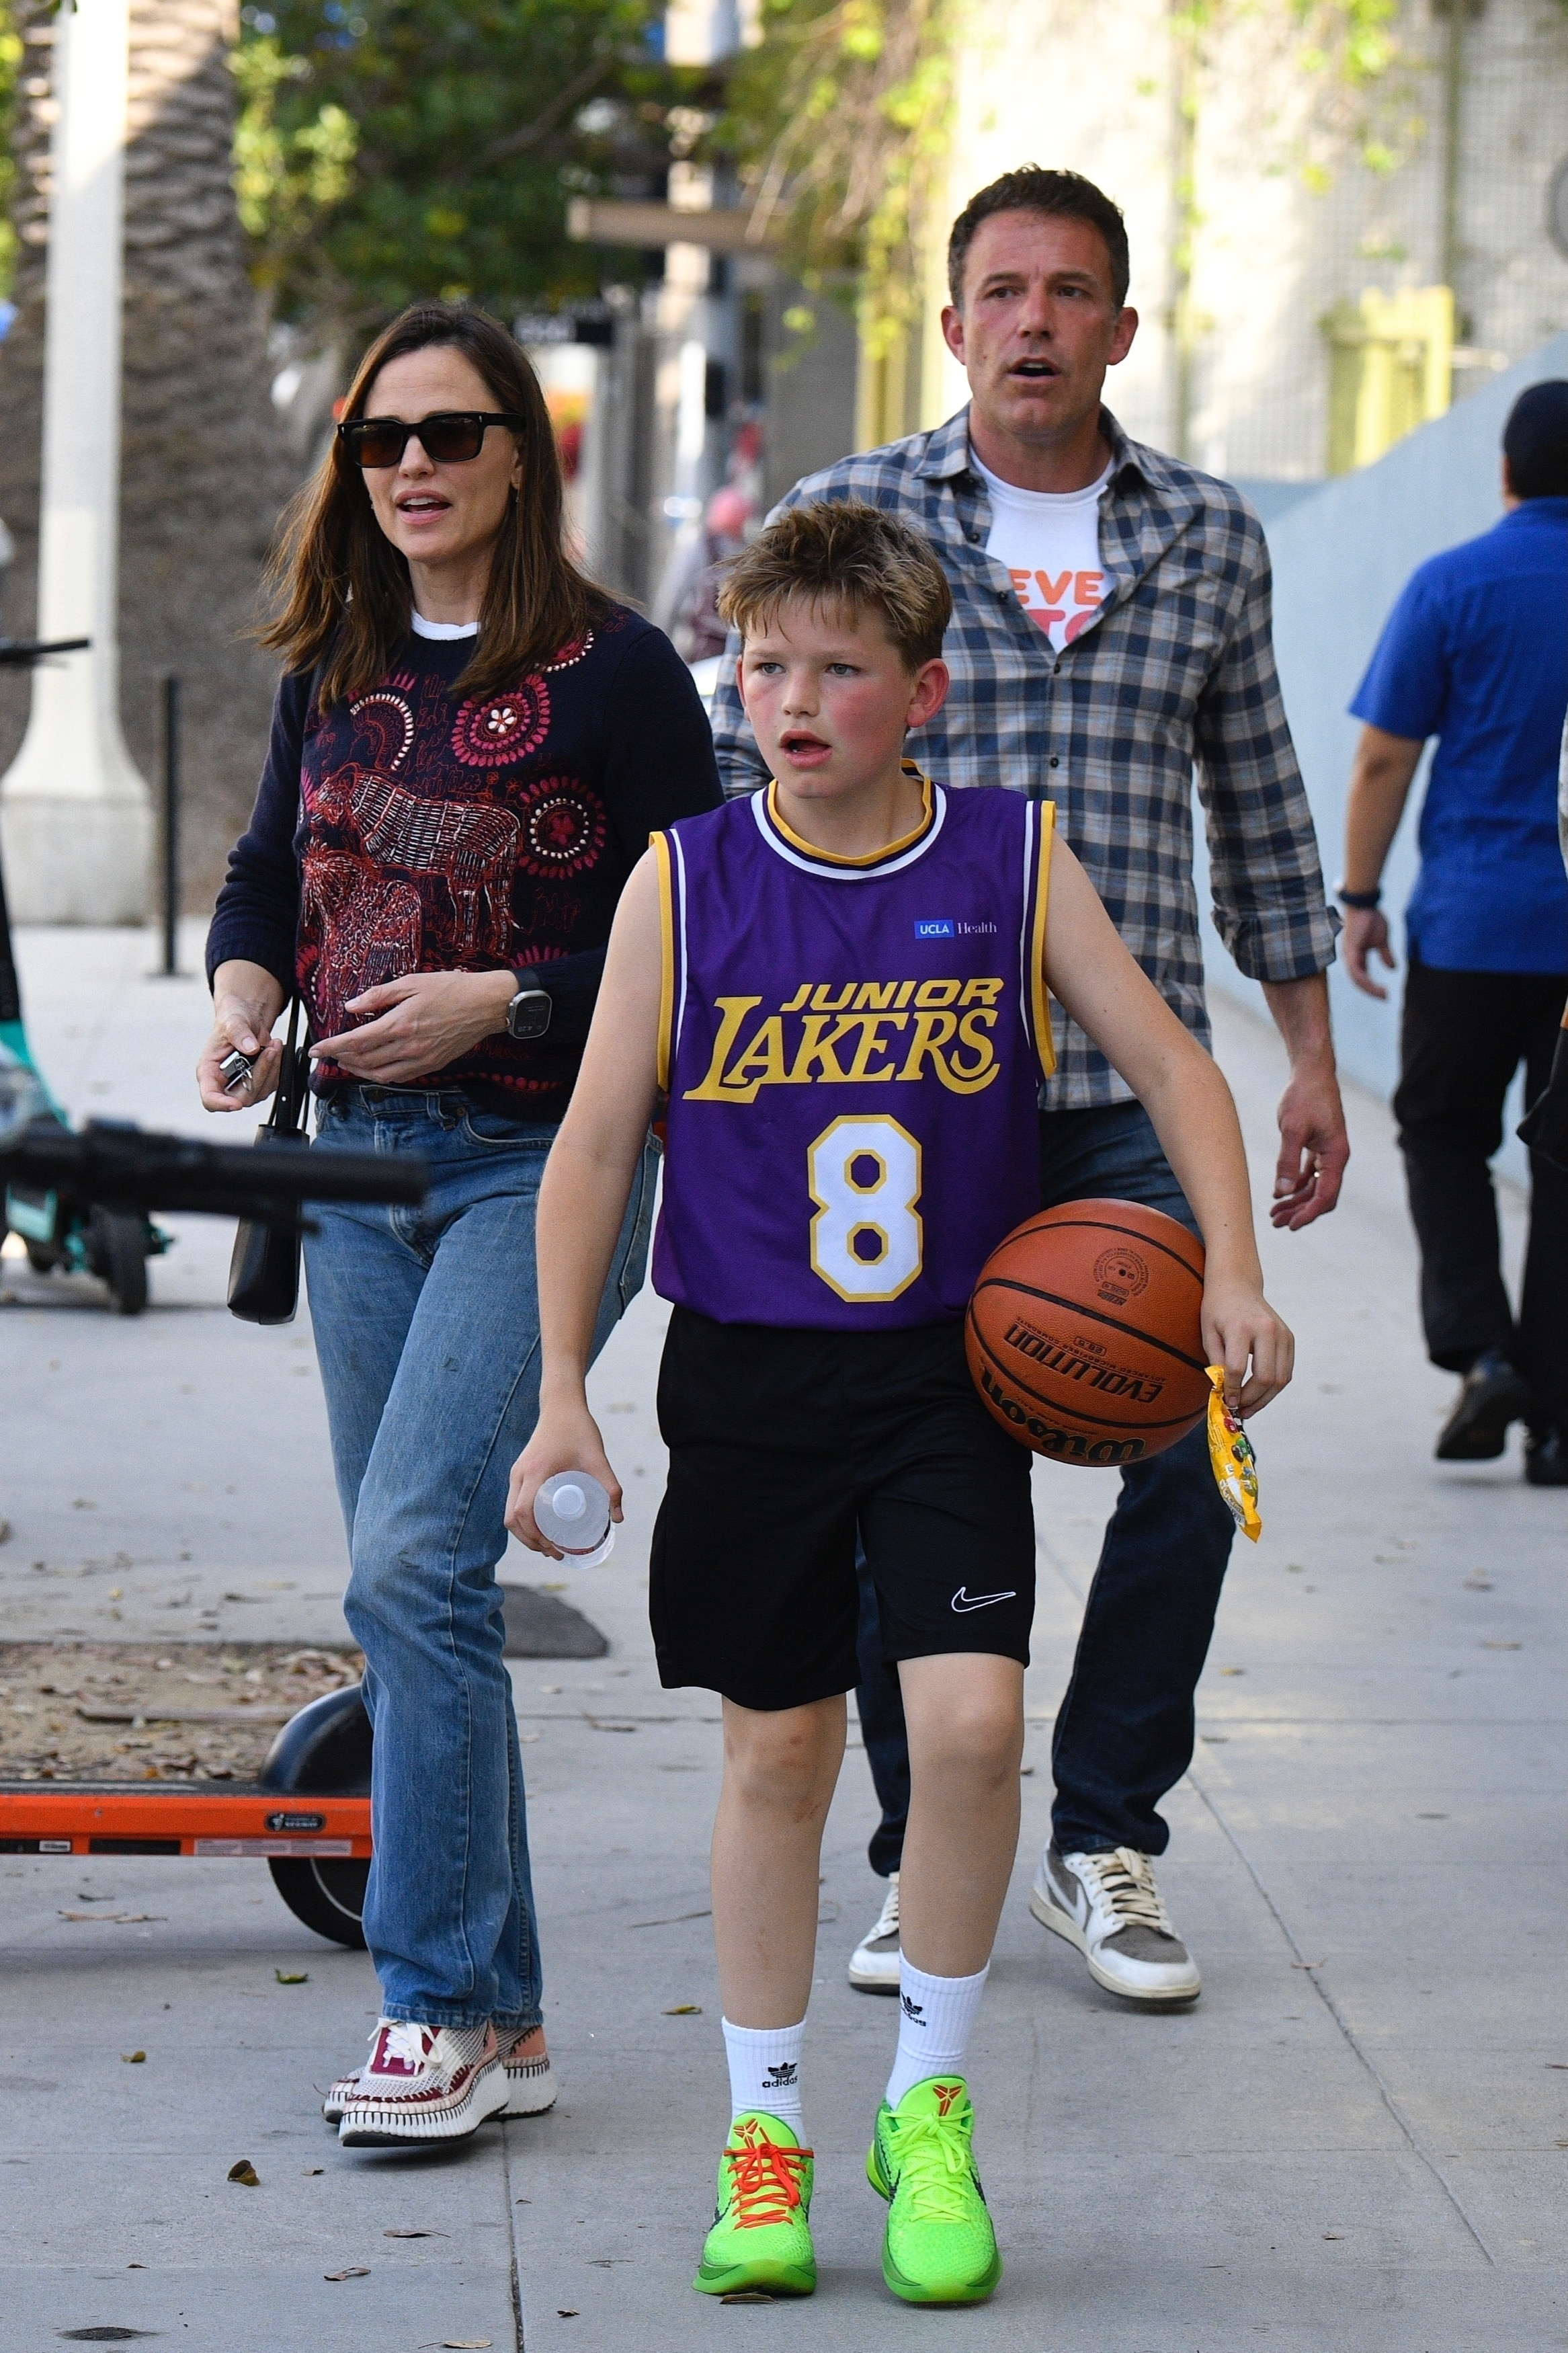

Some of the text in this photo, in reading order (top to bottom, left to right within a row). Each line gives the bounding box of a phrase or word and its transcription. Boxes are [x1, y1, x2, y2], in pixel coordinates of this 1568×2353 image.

[919, 922, 998, 935] UCLA Health
[779, 978, 1004, 1011] JUNIOR
[682, 995, 1000, 1104] LAKERS
[807, 1113, 923, 1303] 8
[1062, 1344, 1118, 1369] MICROFIBER
[1077, 1339, 1104, 1354] 28.5
[1002, 1324, 1165, 1404] EVOLUTION
[1120, 1367, 1166, 1383] ADVANCED
[981, 1367, 1146, 1462] Wilson
[761, 2075, 798, 2088] adidas
